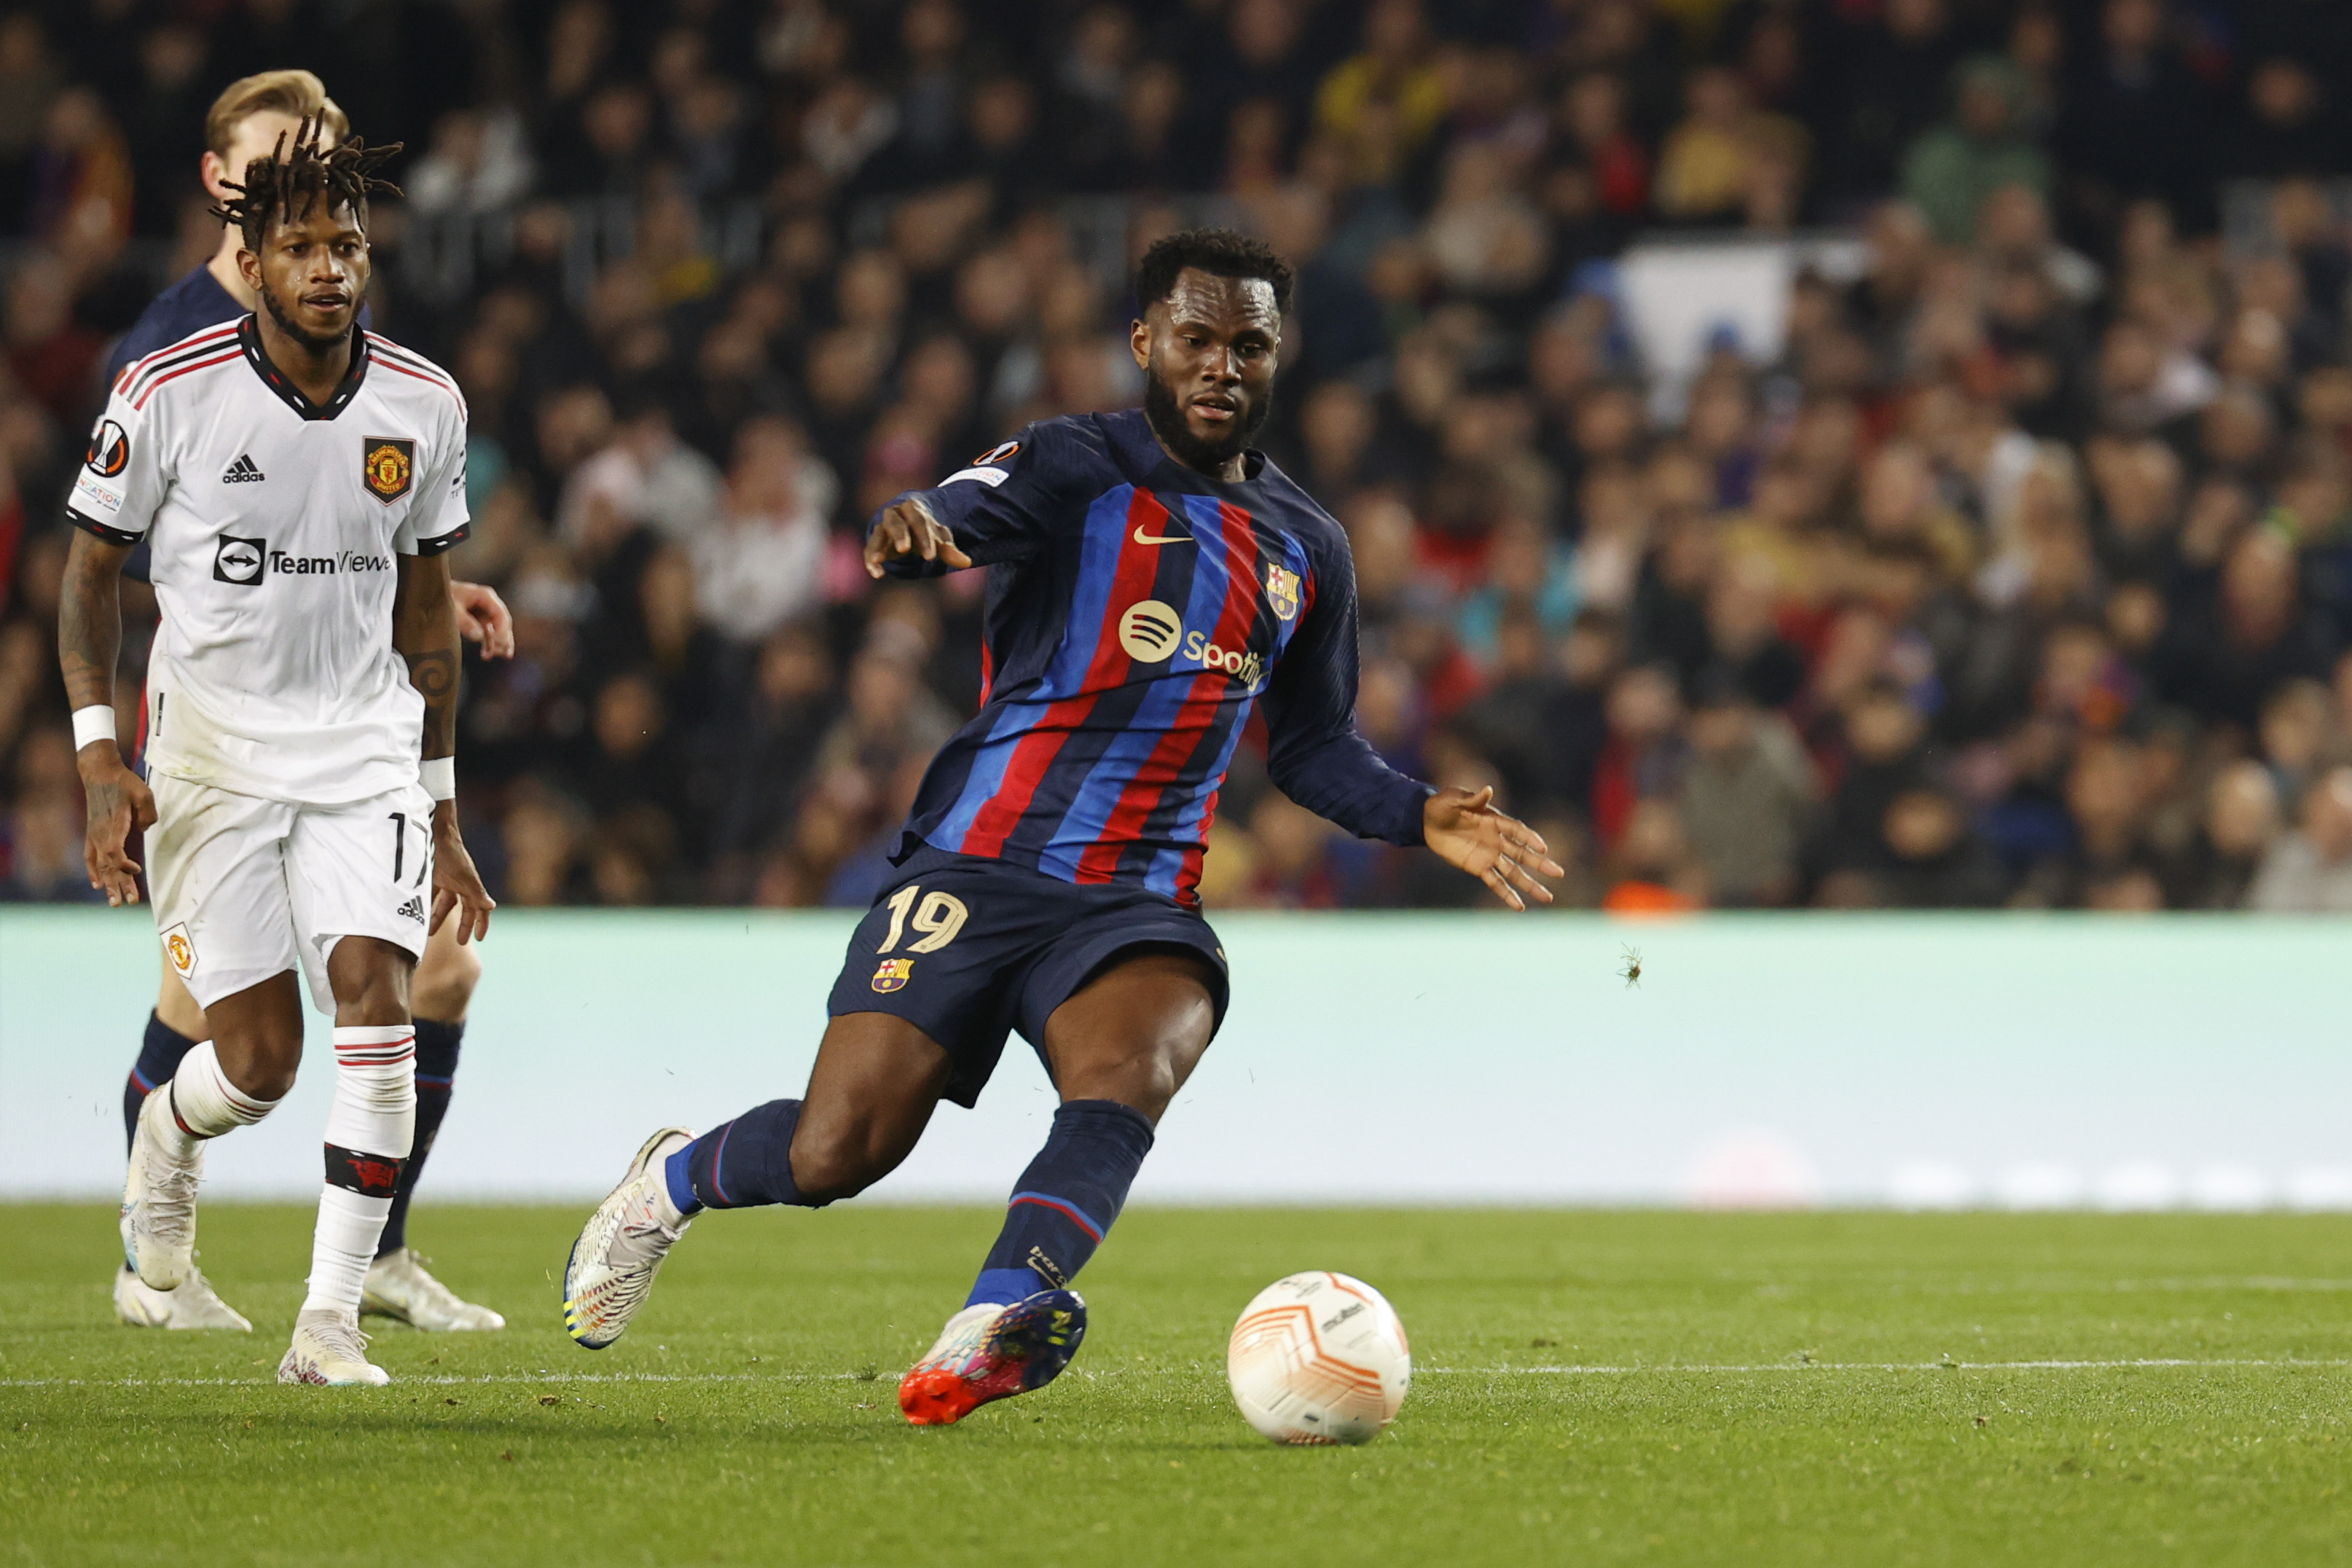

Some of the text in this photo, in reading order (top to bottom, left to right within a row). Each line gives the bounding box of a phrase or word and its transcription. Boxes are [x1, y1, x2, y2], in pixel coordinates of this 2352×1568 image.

[223, 471, 265, 484] adidas
[270, 549, 391, 574] TeamViewe
[1183, 630, 1271, 693] Spotify
[876, 885, 969, 954] 19
